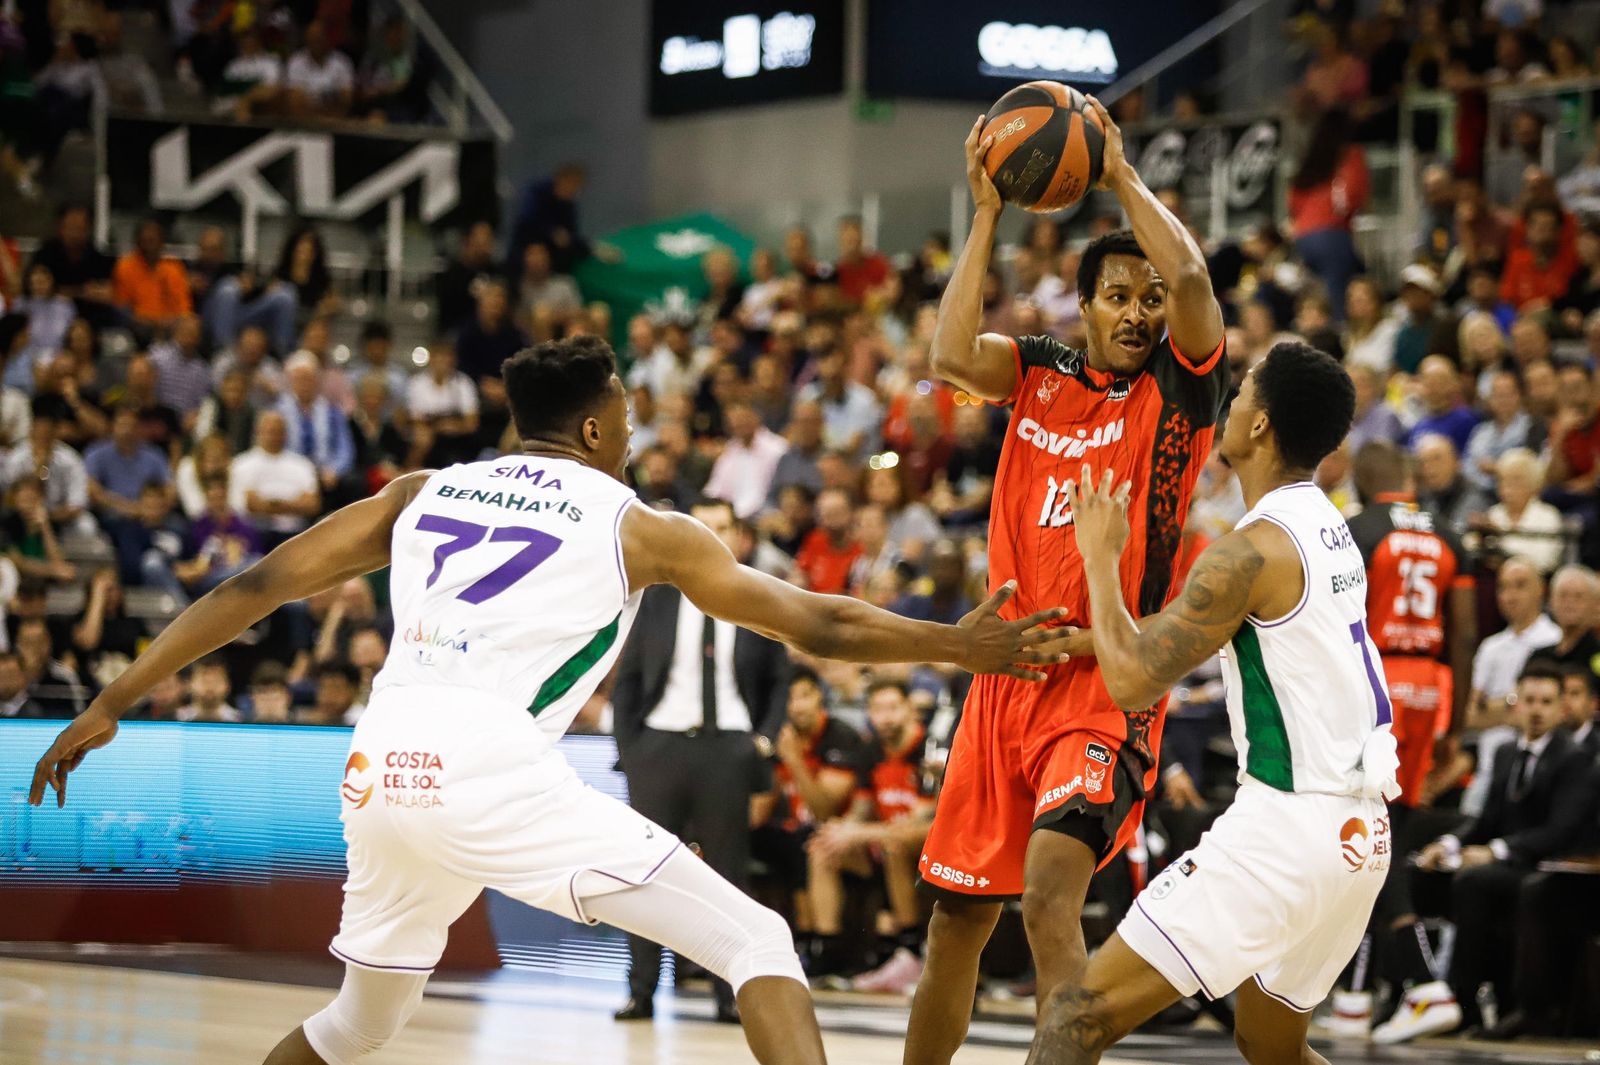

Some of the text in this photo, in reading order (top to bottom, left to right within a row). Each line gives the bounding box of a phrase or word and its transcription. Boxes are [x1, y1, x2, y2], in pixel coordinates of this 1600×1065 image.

[489, 464, 563, 491] SIMA
[437, 485, 583, 523] BENAHAVÍS
[415, 514, 564, 605] 77
[385, 751, 443, 770] COSTA
[412, 775, 441, 789] SOL
[930, 862, 975, 887] asisa
